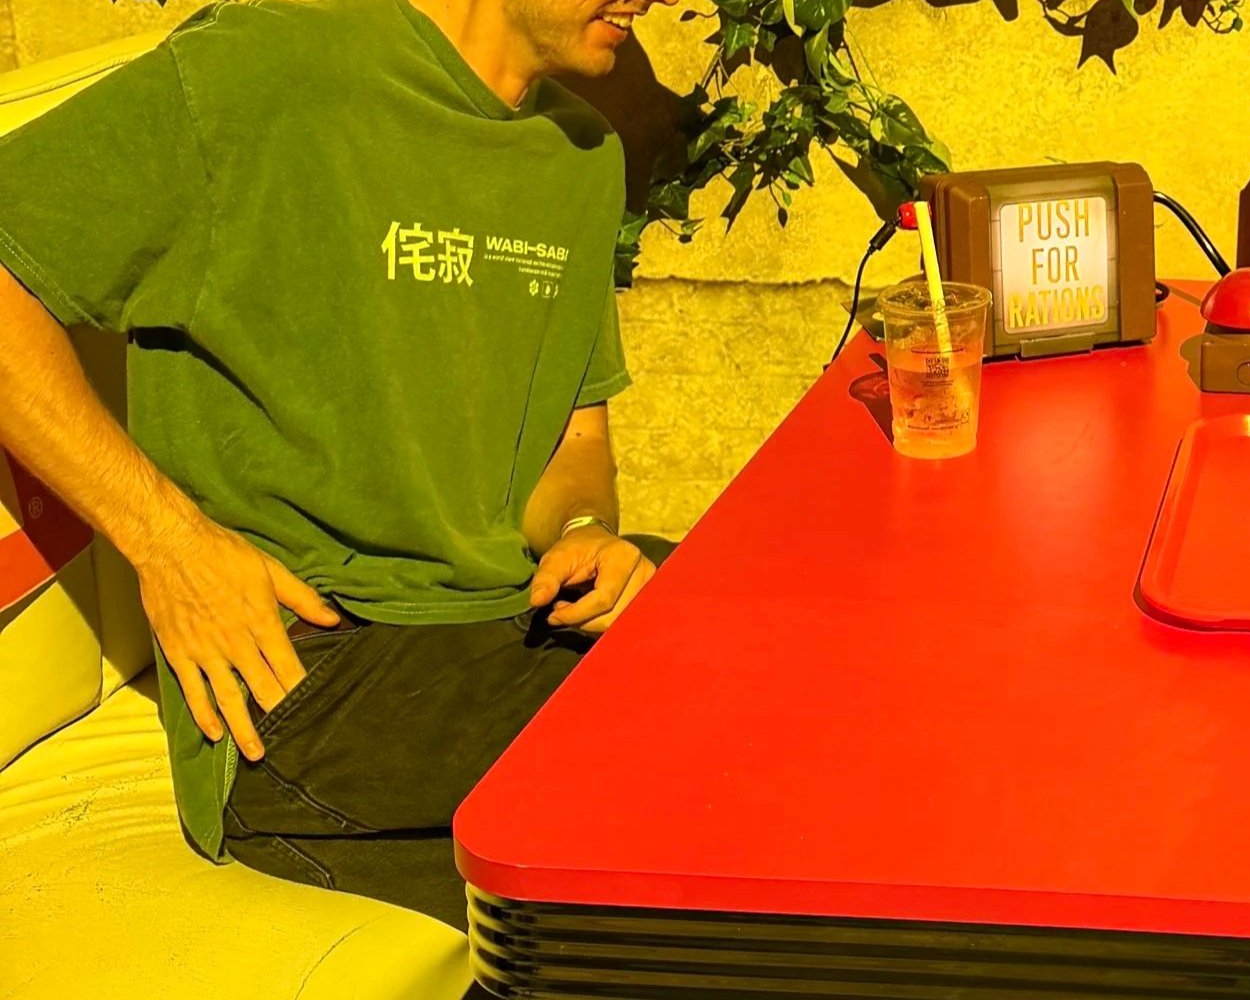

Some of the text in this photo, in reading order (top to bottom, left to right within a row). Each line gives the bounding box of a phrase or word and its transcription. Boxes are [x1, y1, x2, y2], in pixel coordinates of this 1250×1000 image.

[1018, 199, 1089, 242] PUSH
[381, 221, 474, 287] 侘寂
[486, 235, 569, 262] WABI-SABI
[1032, 245, 1080, 285] FOR
[1008, 285, 1105, 328] RATIONS
